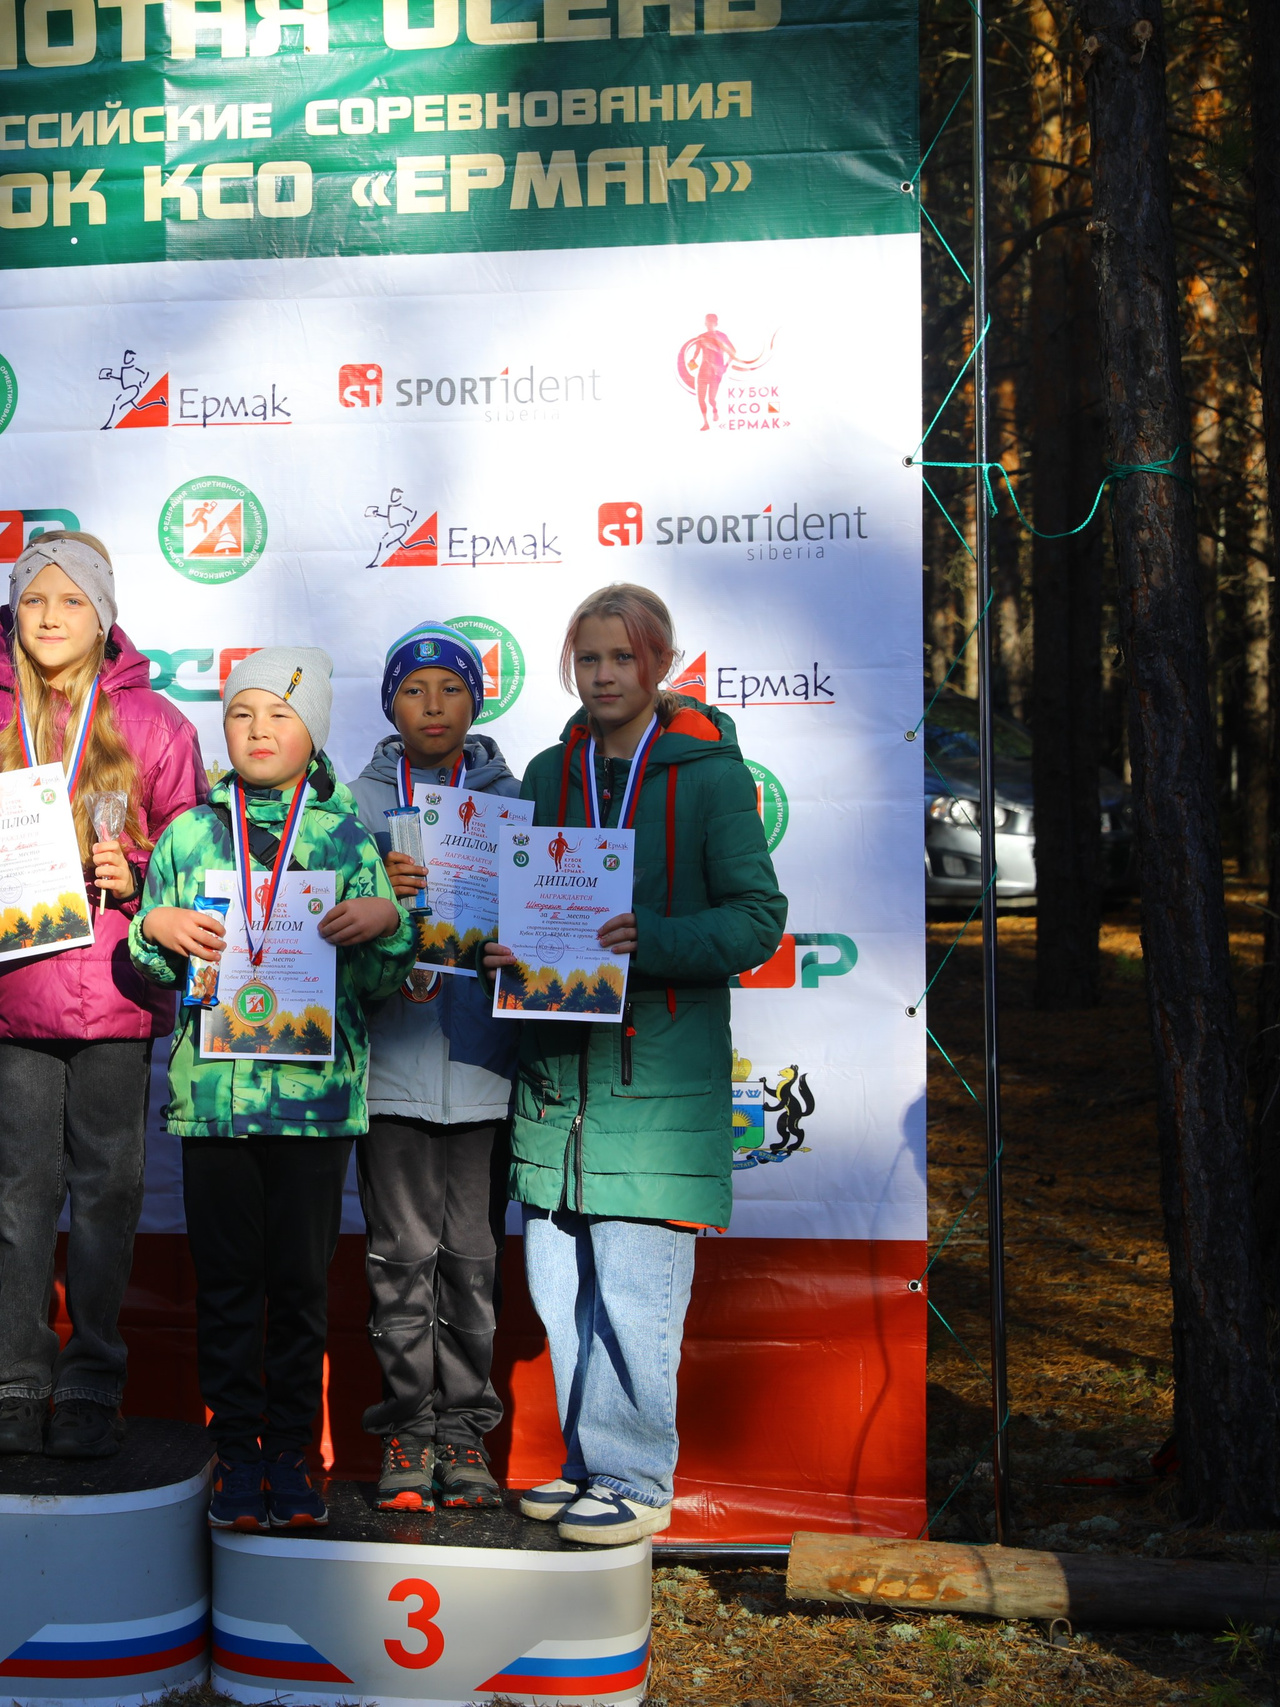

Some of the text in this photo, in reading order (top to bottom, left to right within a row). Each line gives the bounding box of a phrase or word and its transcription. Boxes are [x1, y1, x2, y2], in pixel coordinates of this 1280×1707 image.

[305, 81, 752, 136] СОРЕВНОВАНИЯ
[144, 161, 313, 222] КСО
[351, 144, 752, 214] «ЕРМАК»
[395, 366, 602, 407] SPORTident
[727, 385, 780, 399] КУБОК
[179, 384, 292, 428] Ермак
[484, 406, 561, 423] siberia
[727, 402, 761, 415] КСО
[718, 416, 791, 431] «ЕРМАК»
[163, 480, 263, 580] ФЕДЕРАЦИЯ СПОРТИВНОГО ОРИЕНТИРОВАНИЯ ТЮМЕНСКОЙ ОБЛАСТИ
[656, 502, 868, 546] SPORTident
[447, 522, 562, 568] Ермак
[747, 543, 825, 561] siberia
[449, 620, 520, 708] ПОРТИВНОГО ОРИЕНТИРОВАНИЯ
[717, 662, 835, 709] Ермак
[440, 833, 498, 854] ДИПЛОМ
[444, 851, 493, 866] НАГРАЖДАЕТСЯ
[468, 873, 489, 883] место
[534, 875, 598, 888] ДИПЛОМ
[539, 893, 593, 901] НАГРАЖДАЕТСЯ
[383, 1578, 445, 1670] 3
